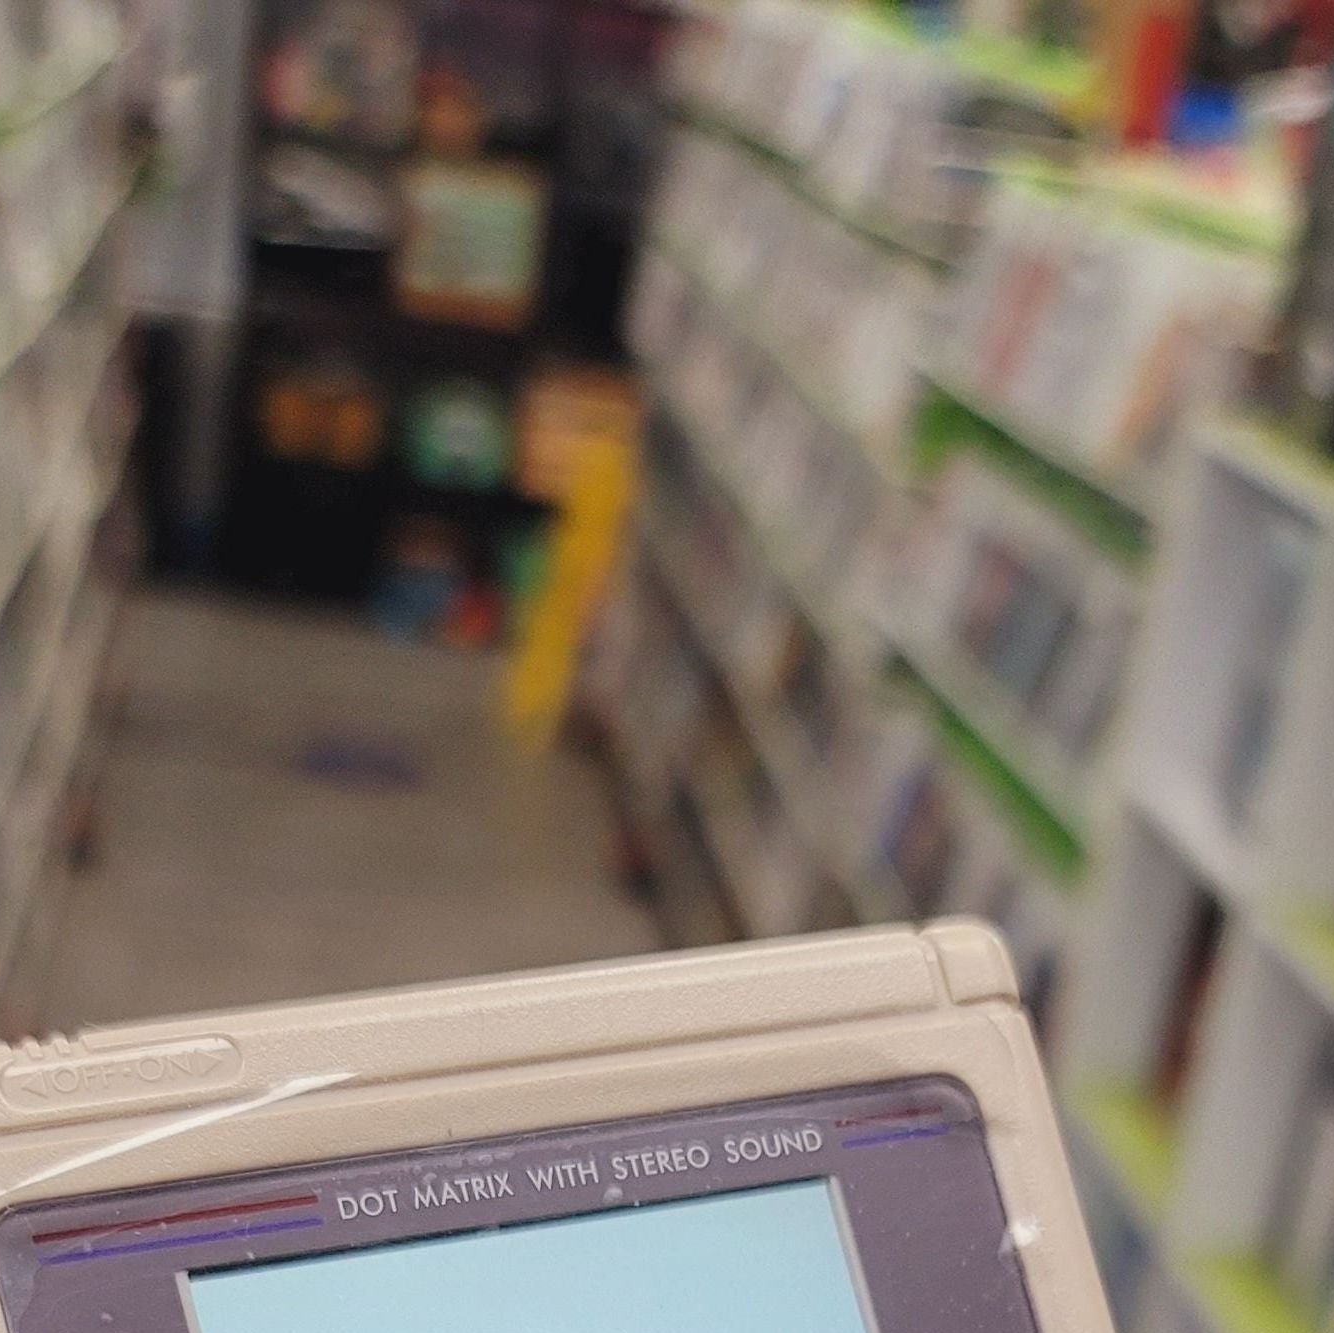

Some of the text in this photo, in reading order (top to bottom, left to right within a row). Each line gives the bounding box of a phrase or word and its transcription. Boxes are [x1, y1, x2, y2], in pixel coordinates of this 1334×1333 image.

[337, 1129, 823, 1220] DOT MATRIX WITH STEREO SOUND
